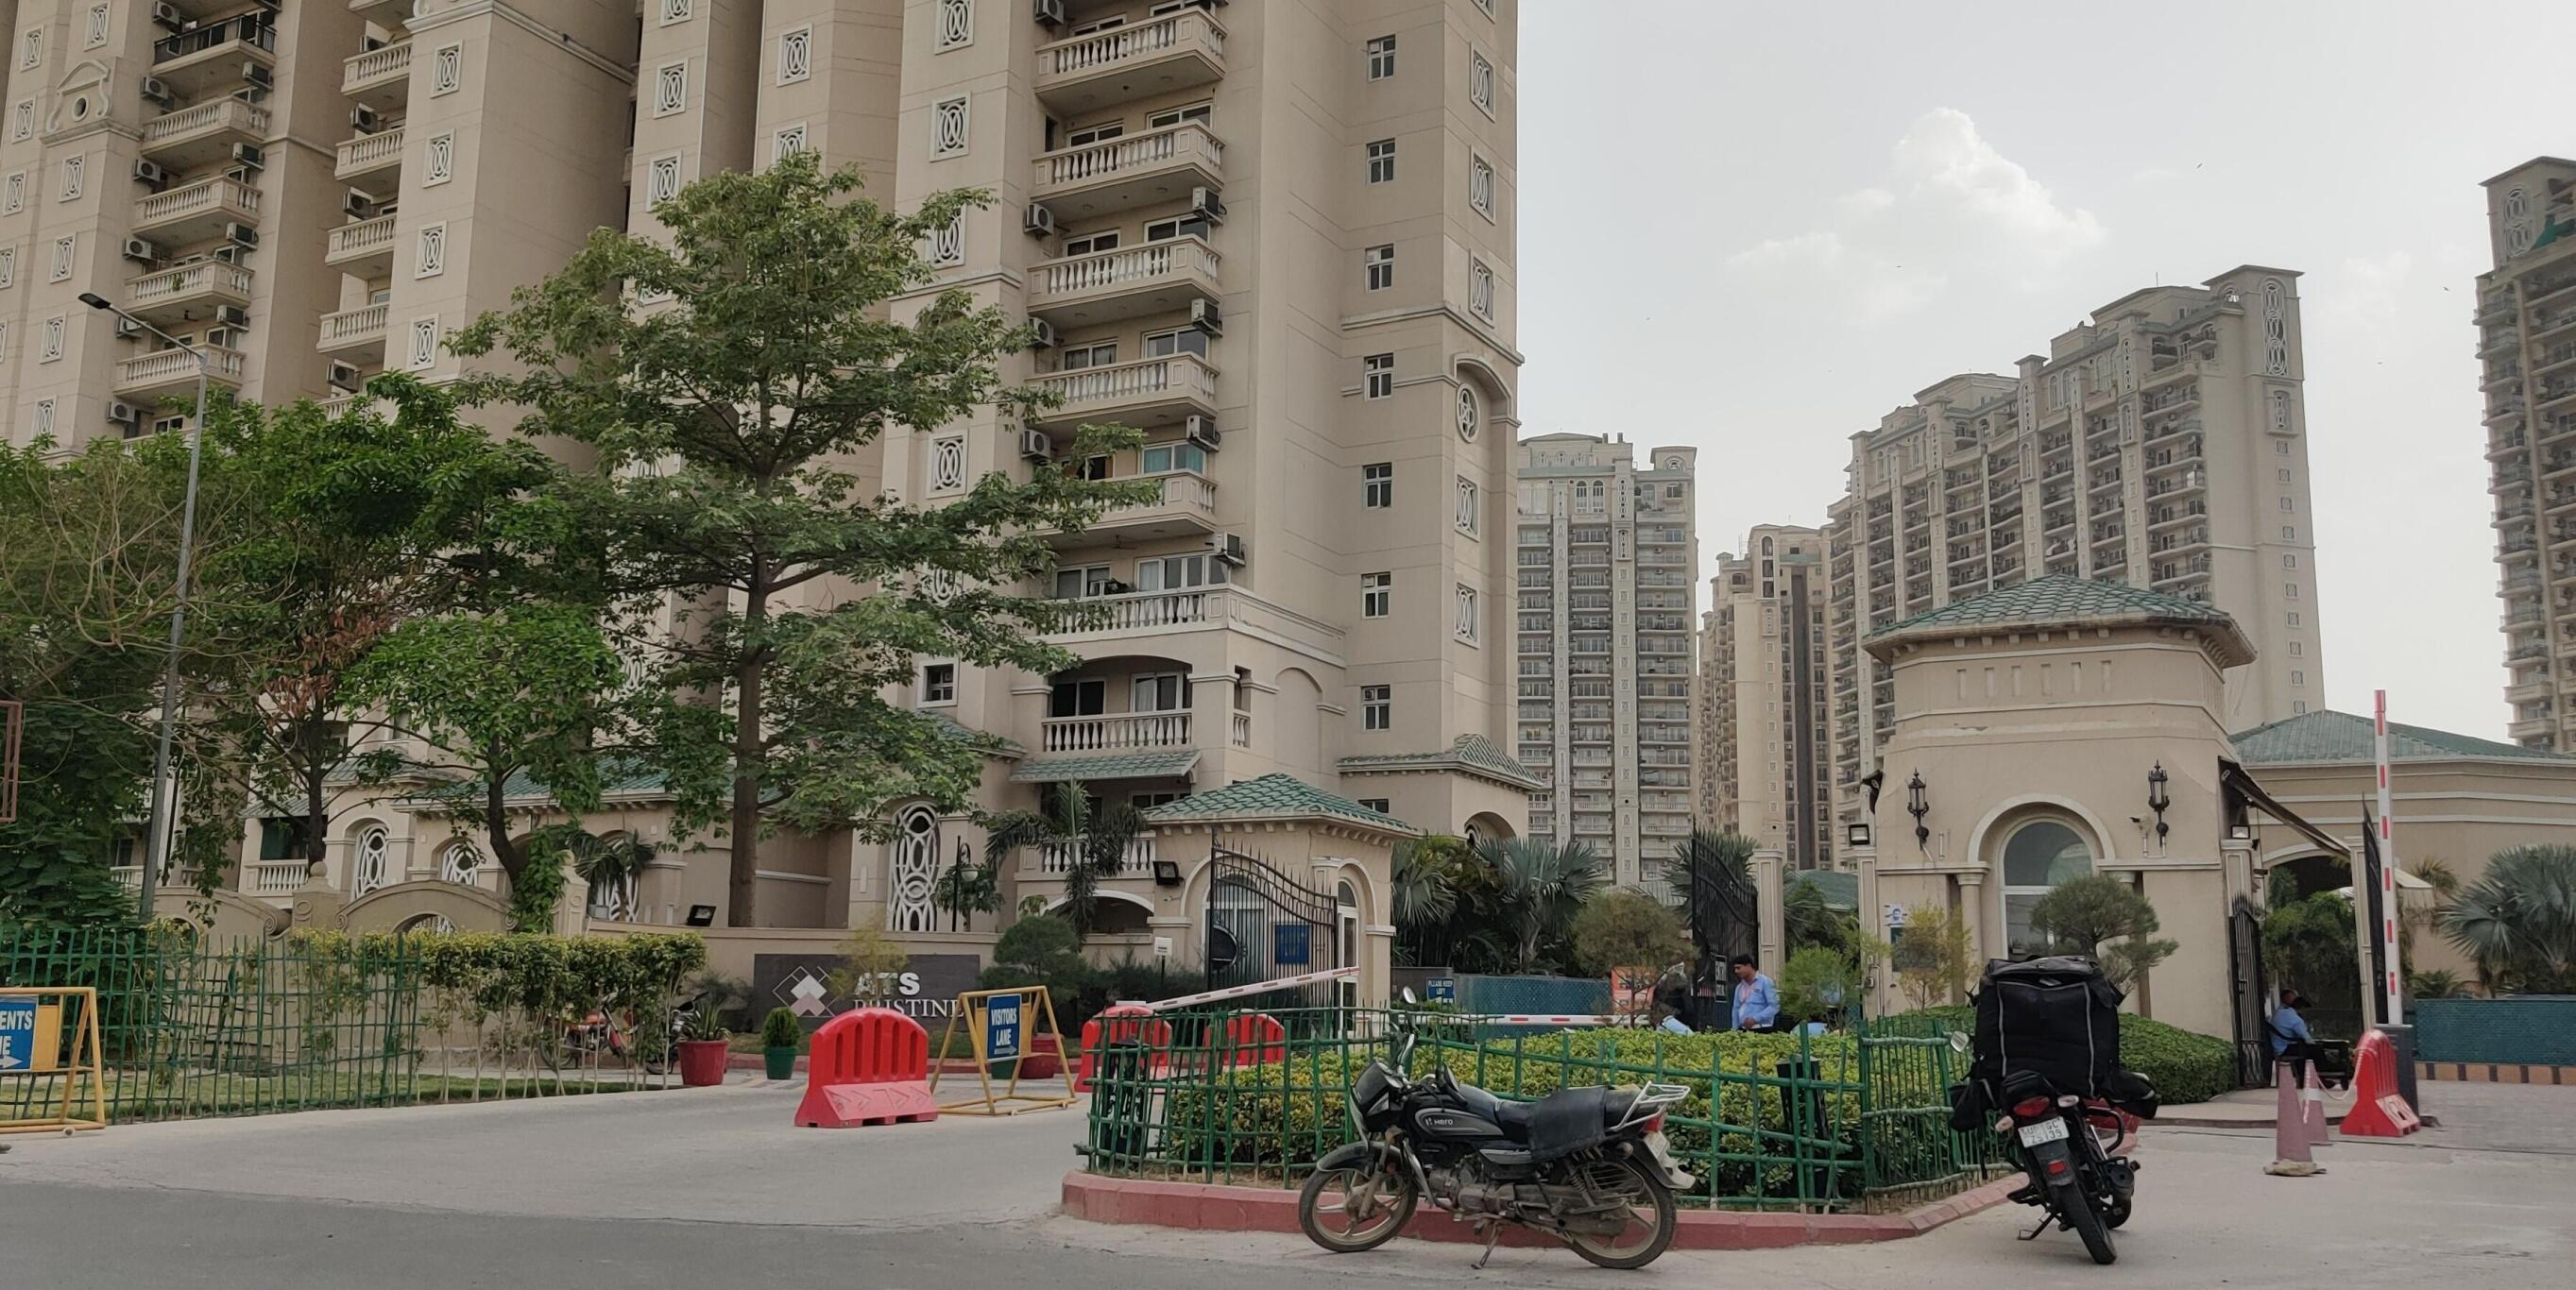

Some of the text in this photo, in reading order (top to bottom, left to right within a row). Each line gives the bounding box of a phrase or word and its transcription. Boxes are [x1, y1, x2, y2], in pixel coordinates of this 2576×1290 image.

[853, 972, 921, 996] ATS
[990, 1007, 1017, 1027] VISITORS
[996, 1027, 1013, 1046] LANE
